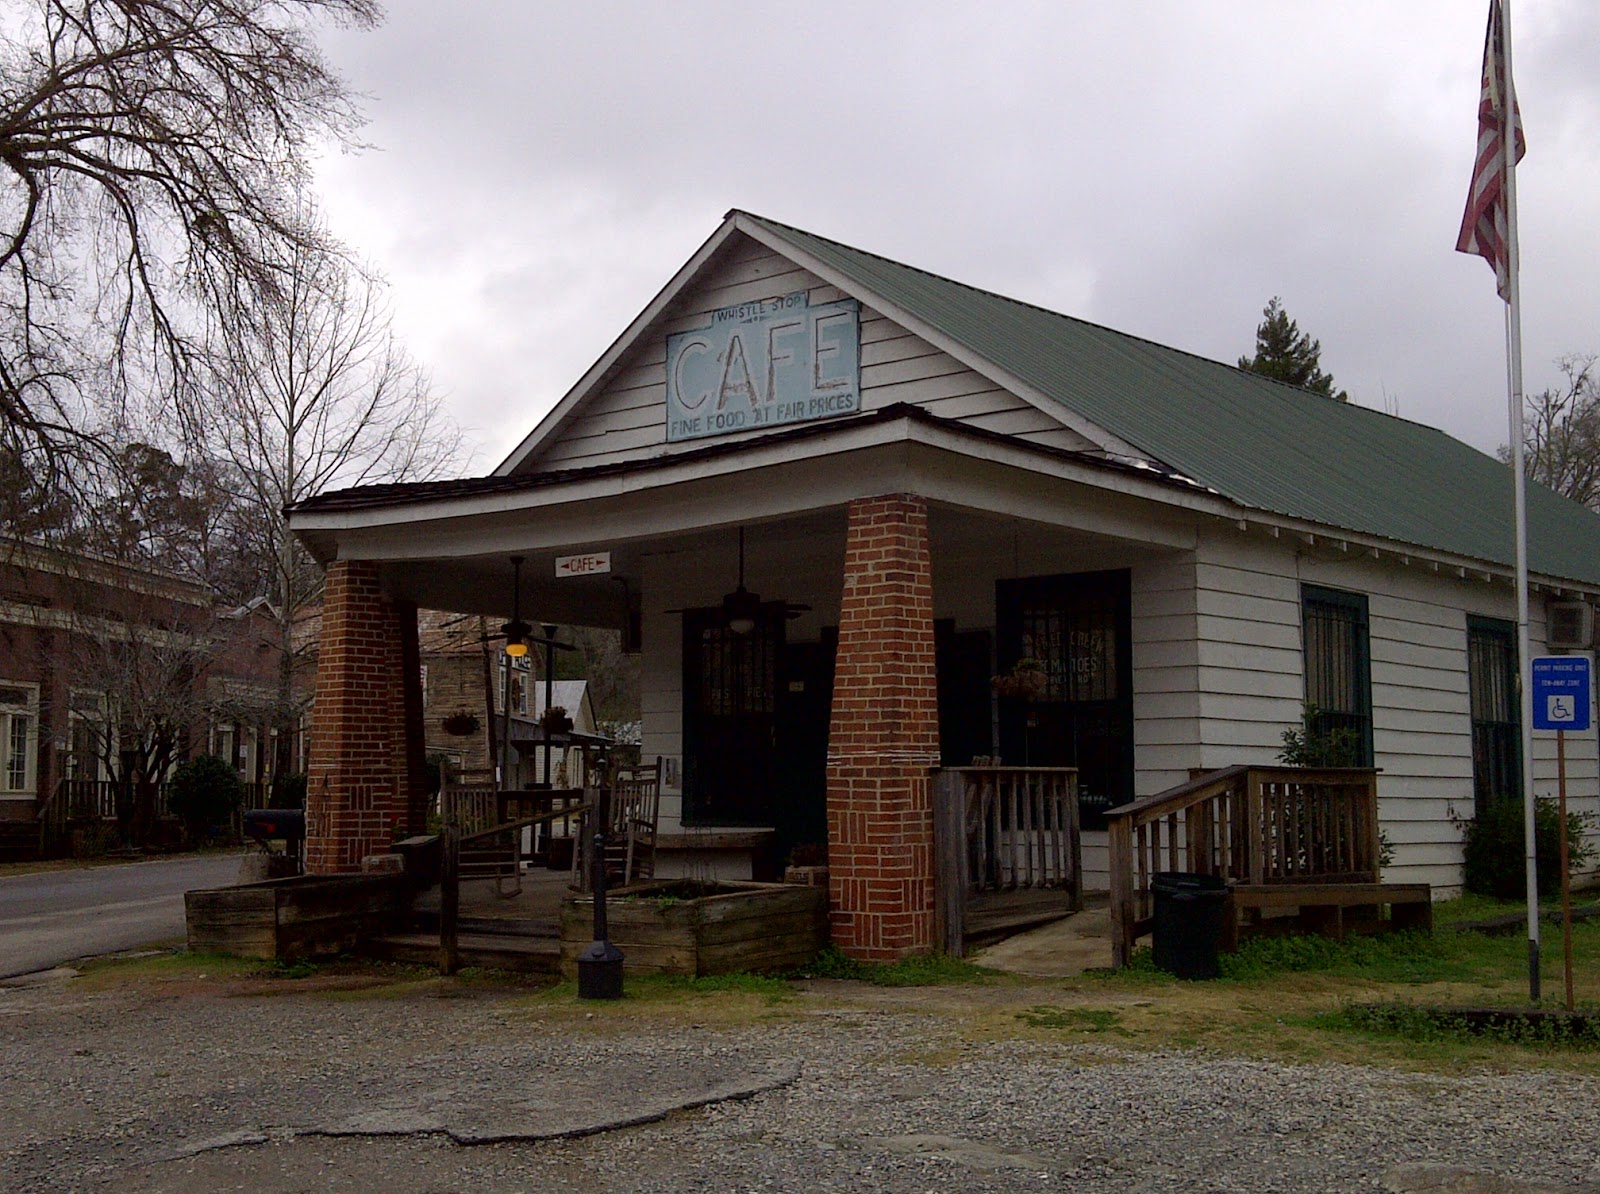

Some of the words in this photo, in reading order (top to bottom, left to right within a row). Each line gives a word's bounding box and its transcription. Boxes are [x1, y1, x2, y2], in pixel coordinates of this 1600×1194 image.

[717, 304, 766, 323] WHISTLE
[772, 295, 801, 311] STOP
[673, 308, 851, 415] CAFE
[671, 418, 702, 438] FINE
[707, 411, 746, 432] FOOD
[753, 406, 770, 424] AT
[777, 402, 805, 420] FAIR
[809, 393, 854, 413] PRICES
[570, 557, 595, 573] CAFE
